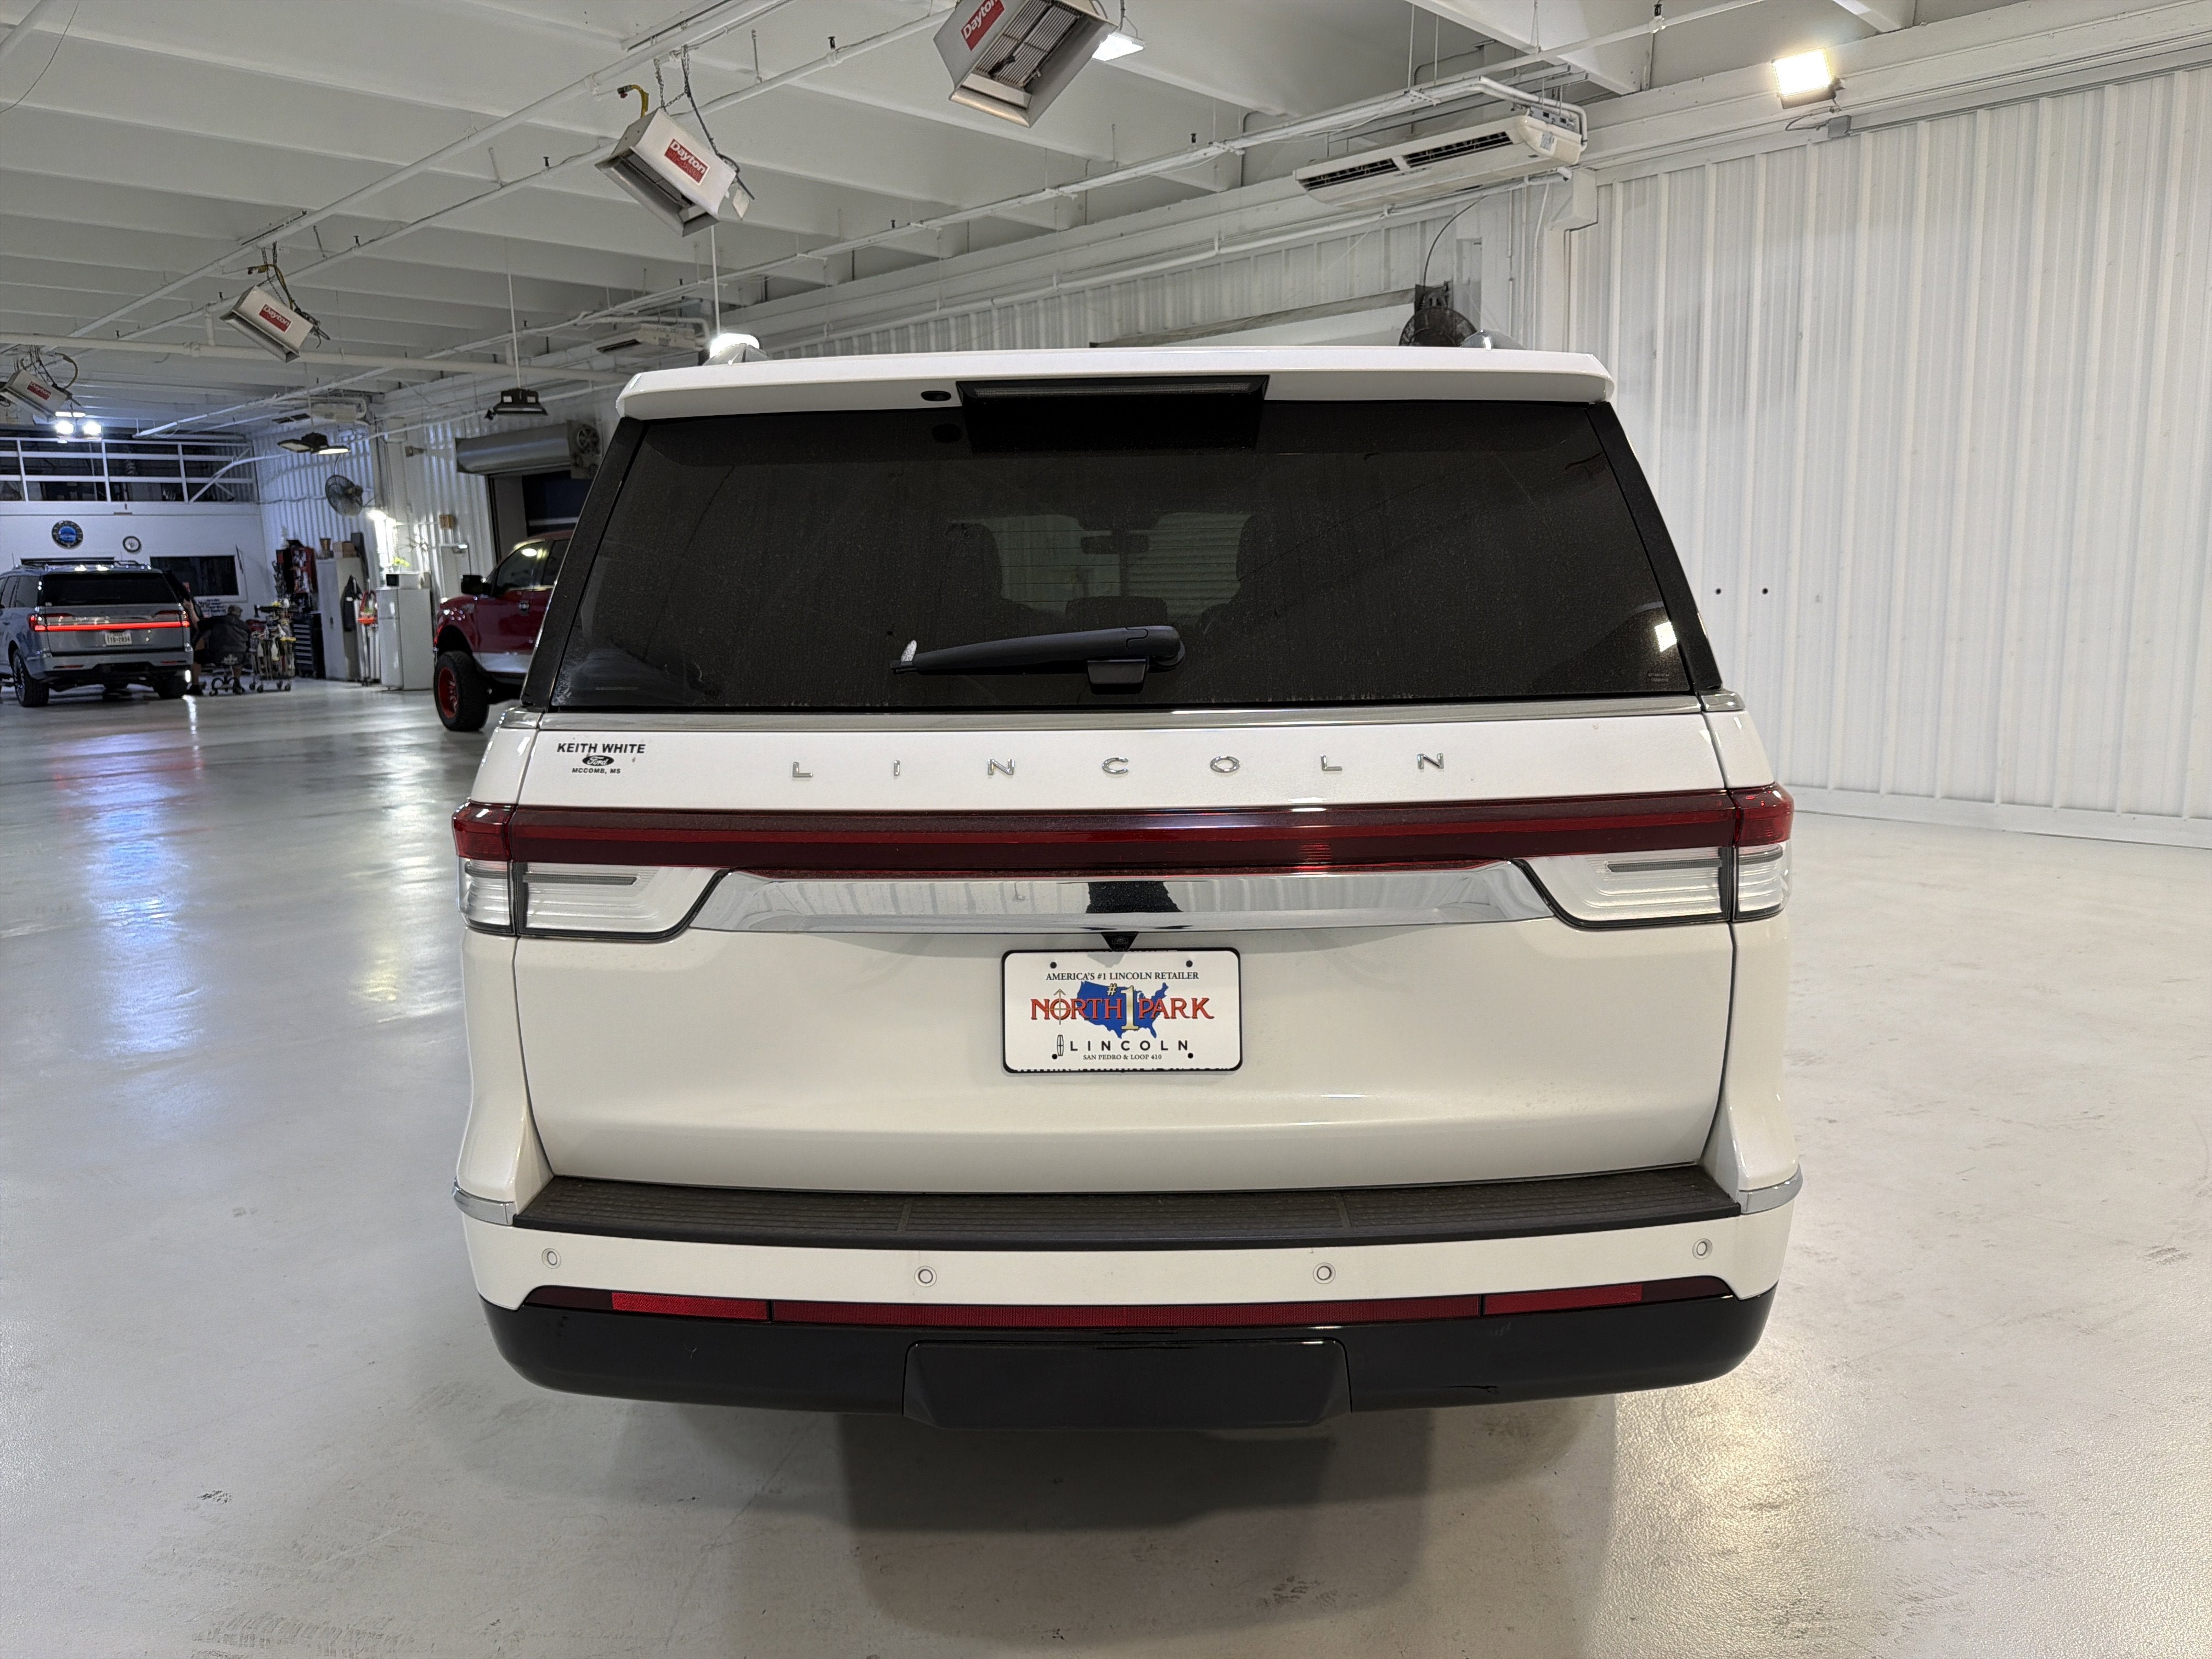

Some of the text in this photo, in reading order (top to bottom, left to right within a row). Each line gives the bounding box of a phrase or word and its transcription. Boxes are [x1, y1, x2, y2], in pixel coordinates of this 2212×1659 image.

[669, 141, 706, 174] Dayton
[263, 306, 290, 326] Dayton
[557, 743, 646, 754] KEITH WHITE
[586, 755, 610, 766] Ford
[792, 752, 1444, 778] LINCOLN
[1046, 972, 1095, 981] AMERICA'S
[1154, 972, 1199, 980] RETAILER
[1030, 997, 1215, 1020] NORTH PARK
[1070, 1040, 1188, 1052] LINCOLN
